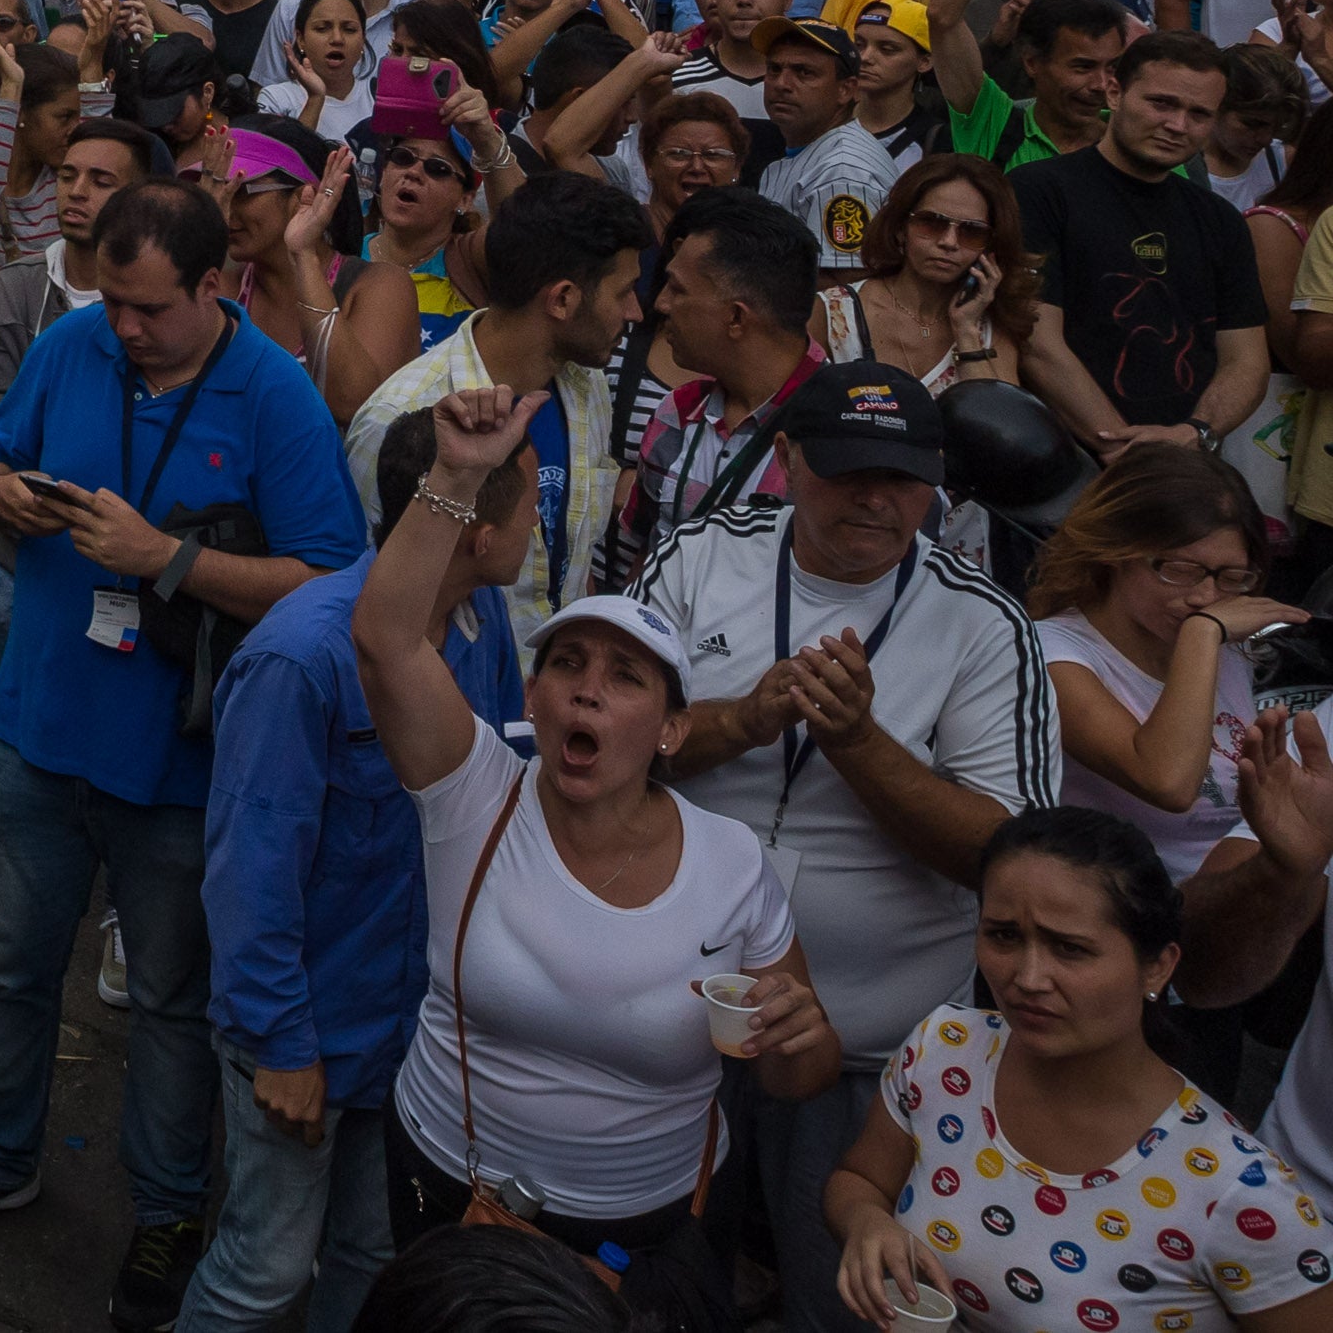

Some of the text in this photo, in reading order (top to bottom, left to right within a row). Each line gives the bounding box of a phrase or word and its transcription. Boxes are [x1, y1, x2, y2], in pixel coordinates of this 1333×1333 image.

[858, 386, 880, 394] HAY
[864, 394, 884, 402] UN
[855, 401, 899, 411] CAMINO
[840, 412, 872, 421] CAPRILES
[109, 600, 127, 608] MUD
[696, 643, 731, 657] adidas
